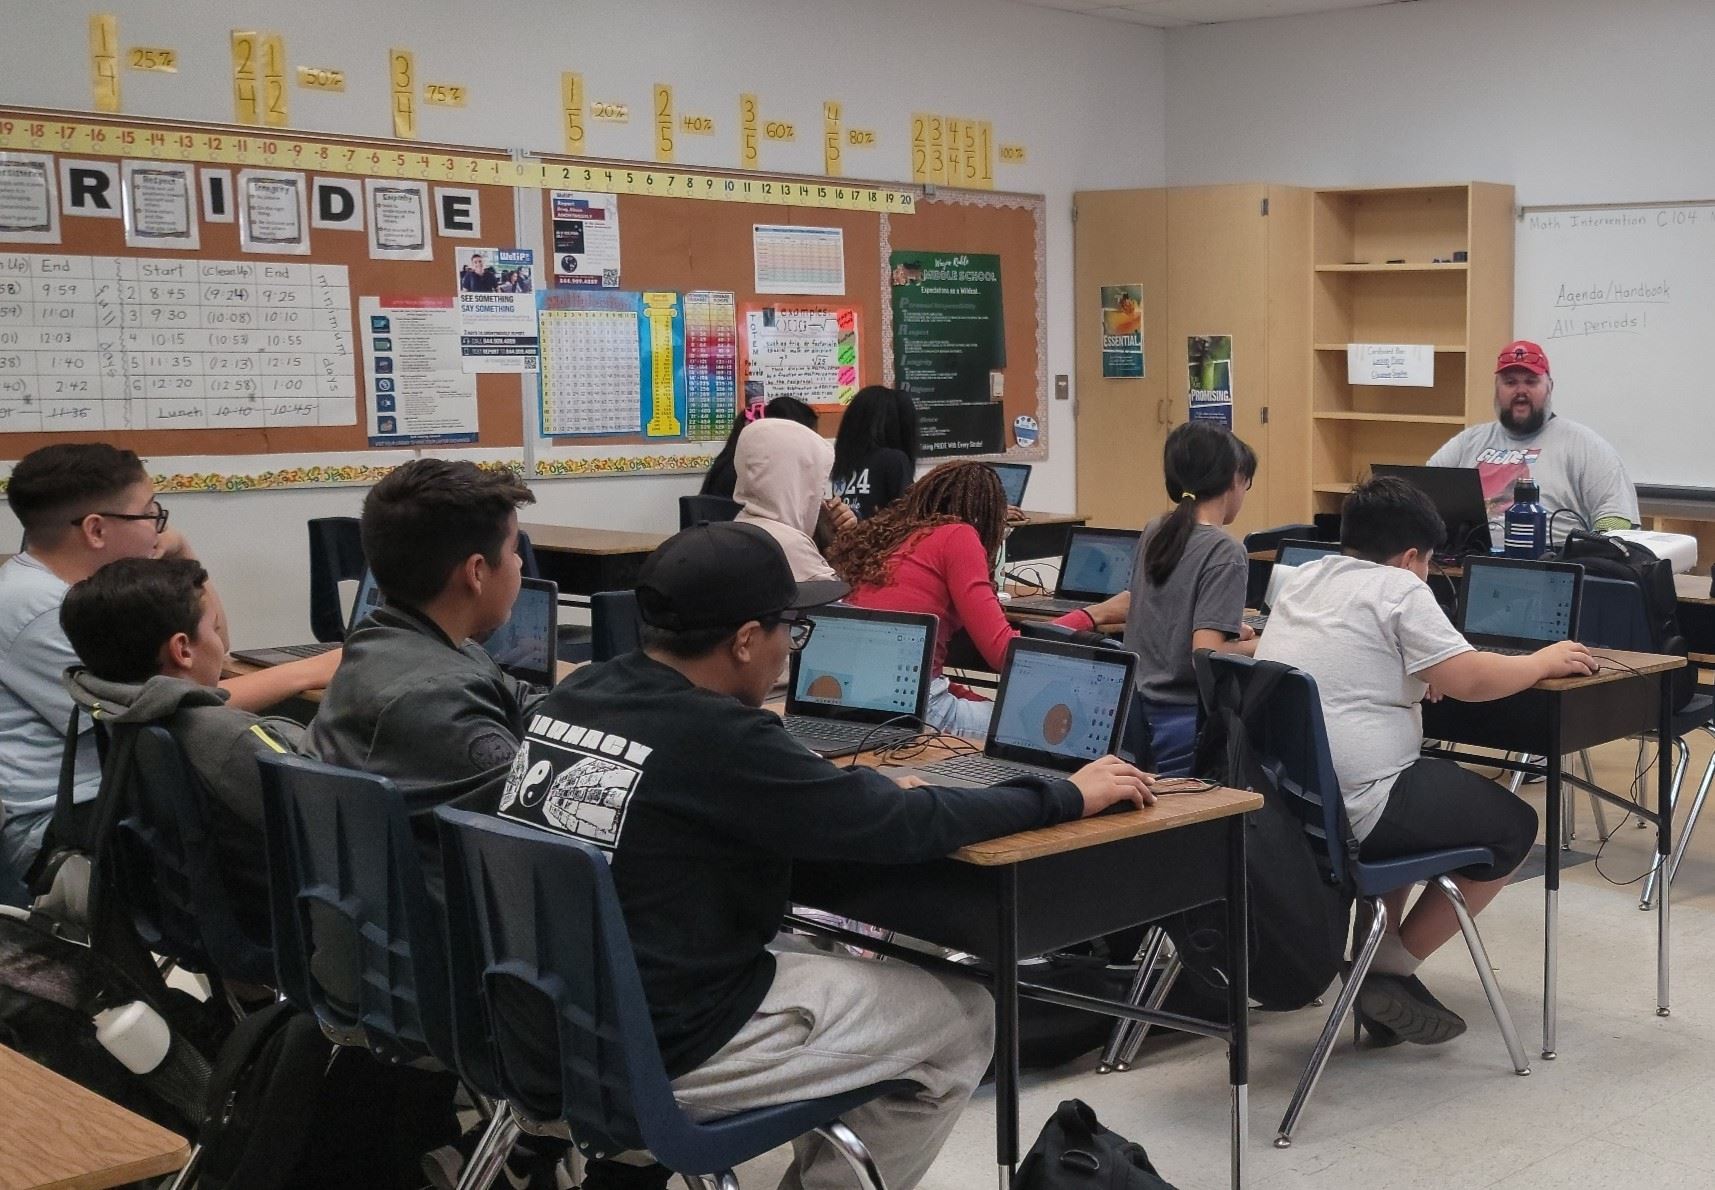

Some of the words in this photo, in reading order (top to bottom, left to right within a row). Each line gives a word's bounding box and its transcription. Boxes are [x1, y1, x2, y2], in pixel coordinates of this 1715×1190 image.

[133, 50, 174, 68] 25%
[237, 40, 254, 73] 2
[97, 60, 116, 95] 4
[395, 56, 410, 87] 3
[238, 84, 257, 114] 4
[269, 81, 286, 114] 2
[428, 85, 461, 101] 75%
[658, 90, 670, 116] 2
[397, 97, 413, 131] 4
[594, 103, 625, 118] 20%
[744, 100, 755, 122] 3
[827, 106, 839, 122] 4
[568, 114, 584, 141] 5
[684, 117, 712, 131] 40%
[766, 123, 793, 137] 60%
[914, 119, 925, 141] 2
[932, 119, 942, 140] 3
[949, 121, 960, 143] 4
[661, 127, 673, 151] 5
[745, 135, 757, 159] 5
[850, 131, 874, 144] 80%
[965, 126, 975, 148] 5
[828, 138, 840, 160] 5
[24, 124, 45, 137] -18
[55, 126, 77, 140] -17
[85, 129, 106, 142] -16
[115, 131, 135, 144] -15
[144, 133, 165, 147] -14
[173, 136, 193, 149] -13
[203, 137, 223, 151] -12
[232, 139, 248, 153] -11
[257, 141, 278, 155] -10
[287, 144, 303, 157] -9
[314, 147, 329, 160] -8
[342, 150, 356, 162] -7
[366, 152, 380, 164] -6
[391, 154, 406, 167] -5
[416, 155, 430, 168] -4
[441, 158, 454, 171] -3
[466, 160, 479, 173] -2
[491, 162, 499, 174] -1
[516, 163, 524, 176] 0
[541, 166, 546, 178] 1
[562, 168, 570, 179] 2
[584, 169, 592, 181] 3
[604, 170, 612, 182] 4
[626, 172, 634, 184] 5
[646, 174, 654, 186] 6
[668, 176, 676, 187] 7
[686, 177, 694, 189] 8
[706, 179, 713, 190] 9
[724, 180, 735, 192] 10
[743, 182, 751, 193] 11
[761, 183, 772, 195] 12
[781, 185, 791, 196] 13
[799, 186, 809, 197] 14
[817, 187, 827, 198] 15
[835, 188, 845, 200] 16
[851, 190, 860, 201] 17
[868, 191, 878, 202] 18
[886, 192, 894, 204] 19
[900, 194, 912, 205] 20
[915, 152, 926, 173] 2
[932, 152, 943, 172] 3
[949, 154, 960, 175] 4
[966, 156, 976, 178] 5
[69, 168, 112, 209] R
[208, 177, 225, 215] I
[318, 185, 355, 222] D
[442, 195, 473, 232] E
[1530, 217, 1561, 231] Math
[1570, 214, 1646, 228] Intervention
[41, 259, 71, 273] End
[143, 264, 183, 277] Start
[264, 268, 290, 279] End
[460, 295, 474, 303] SEE
[475, 295, 514, 304] SOMETHING
[461, 305, 474, 313] SAY
[475, 305, 516, 313] SOMETHING
[1552, 320, 1574, 337] All
[844, 468, 870, 495] 24
